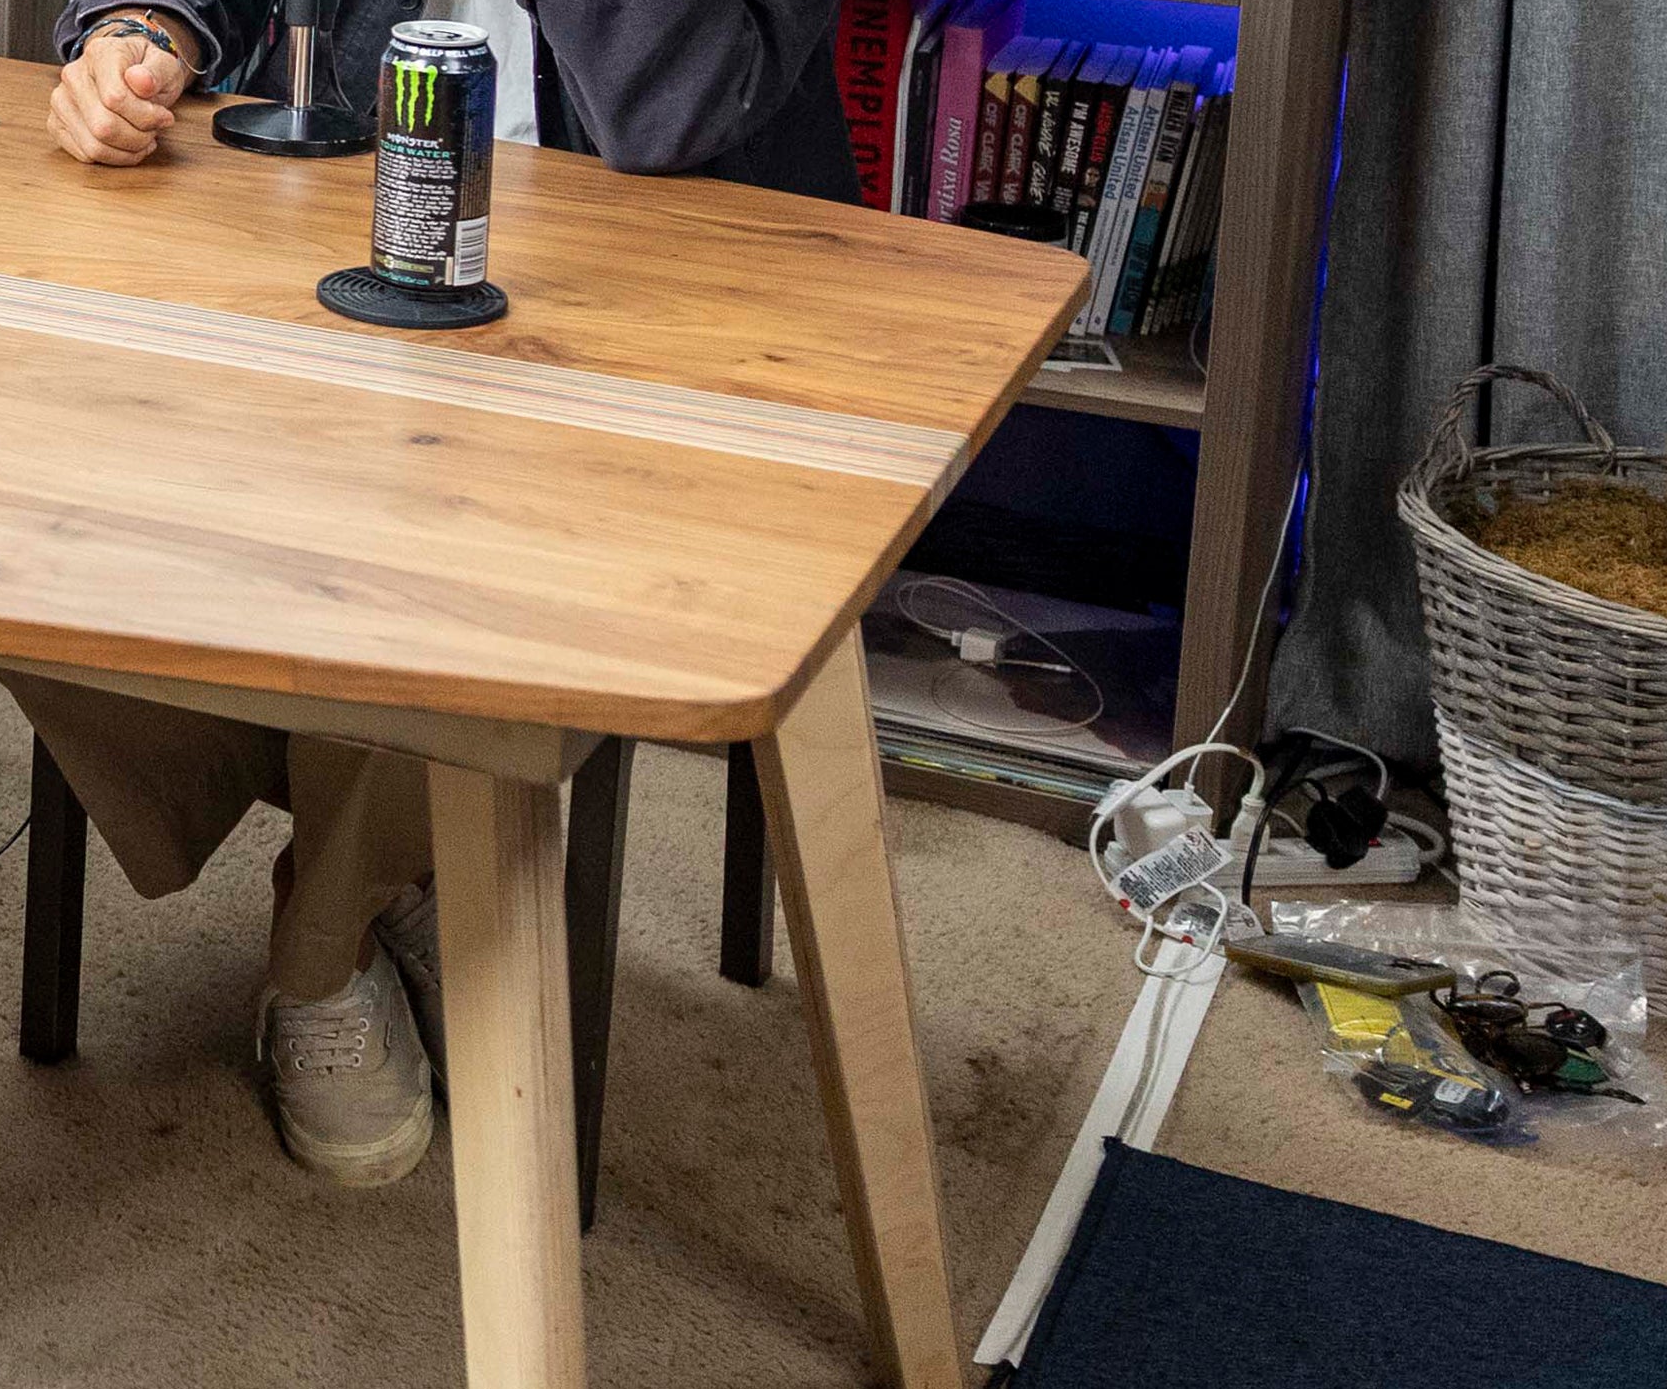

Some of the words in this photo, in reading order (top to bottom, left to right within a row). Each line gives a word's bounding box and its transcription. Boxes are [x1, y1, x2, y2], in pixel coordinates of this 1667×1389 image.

[386, 131, 440, 150] MONSTER
[1113, 105, 1139, 155] Artisan
[1134, 105, 1161, 155] Artisan
[1101, 155, 1125, 202] United
[1122, 155, 1146, 202] United
